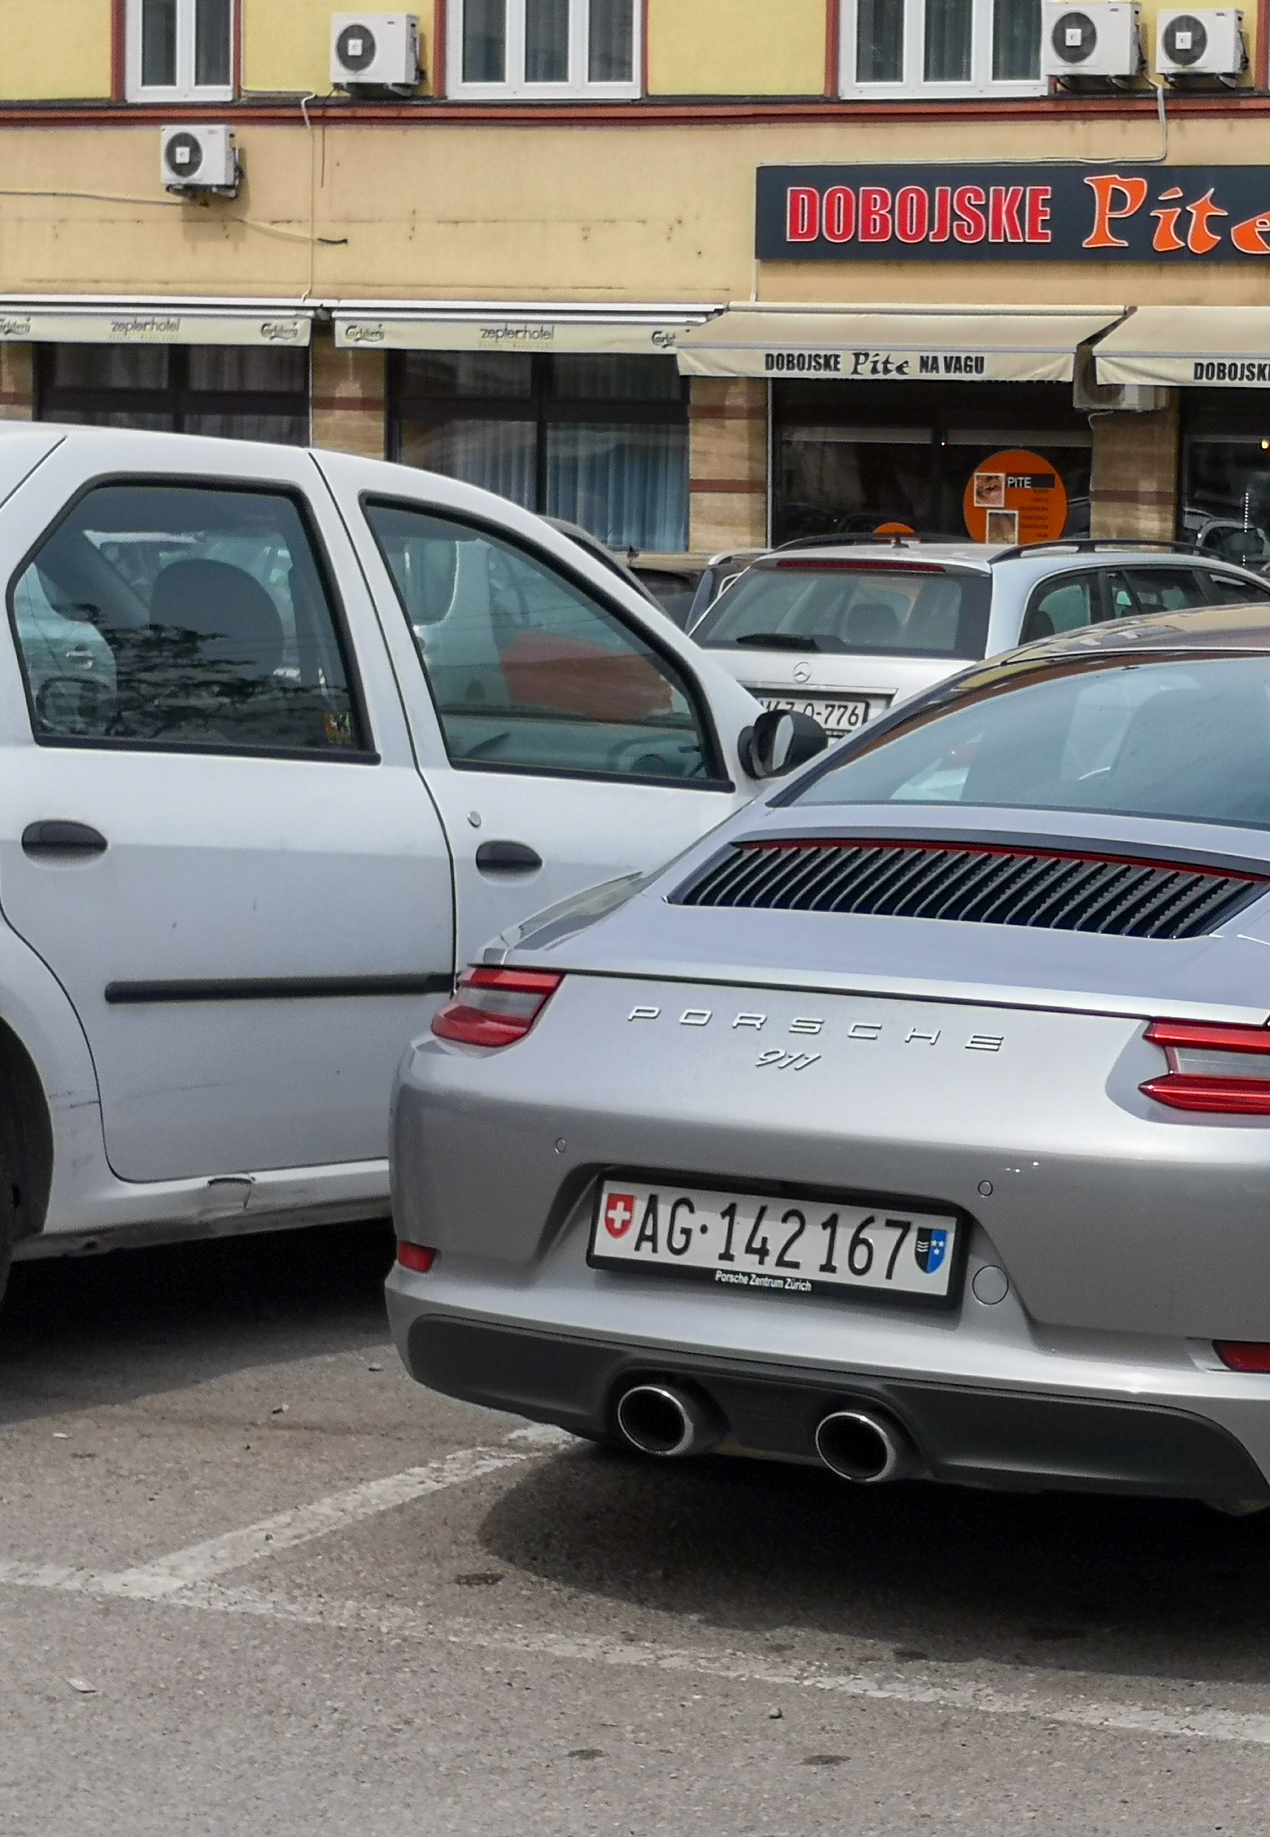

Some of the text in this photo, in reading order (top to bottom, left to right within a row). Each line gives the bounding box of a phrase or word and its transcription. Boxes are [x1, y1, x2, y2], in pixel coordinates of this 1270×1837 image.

[786, 186, 1053, 244] DOBOJSKE
[765, 351, 985, 376] DOBOJSKE Pite NA VAGU
[1007, 476, 1032, 488] PITE
[628, 1004, 1004, 1052] PORSCHE
[755, 1048, 821, 1071] 911
[715, 1269, 812, 1292] Porsche Zentrum Zürich
